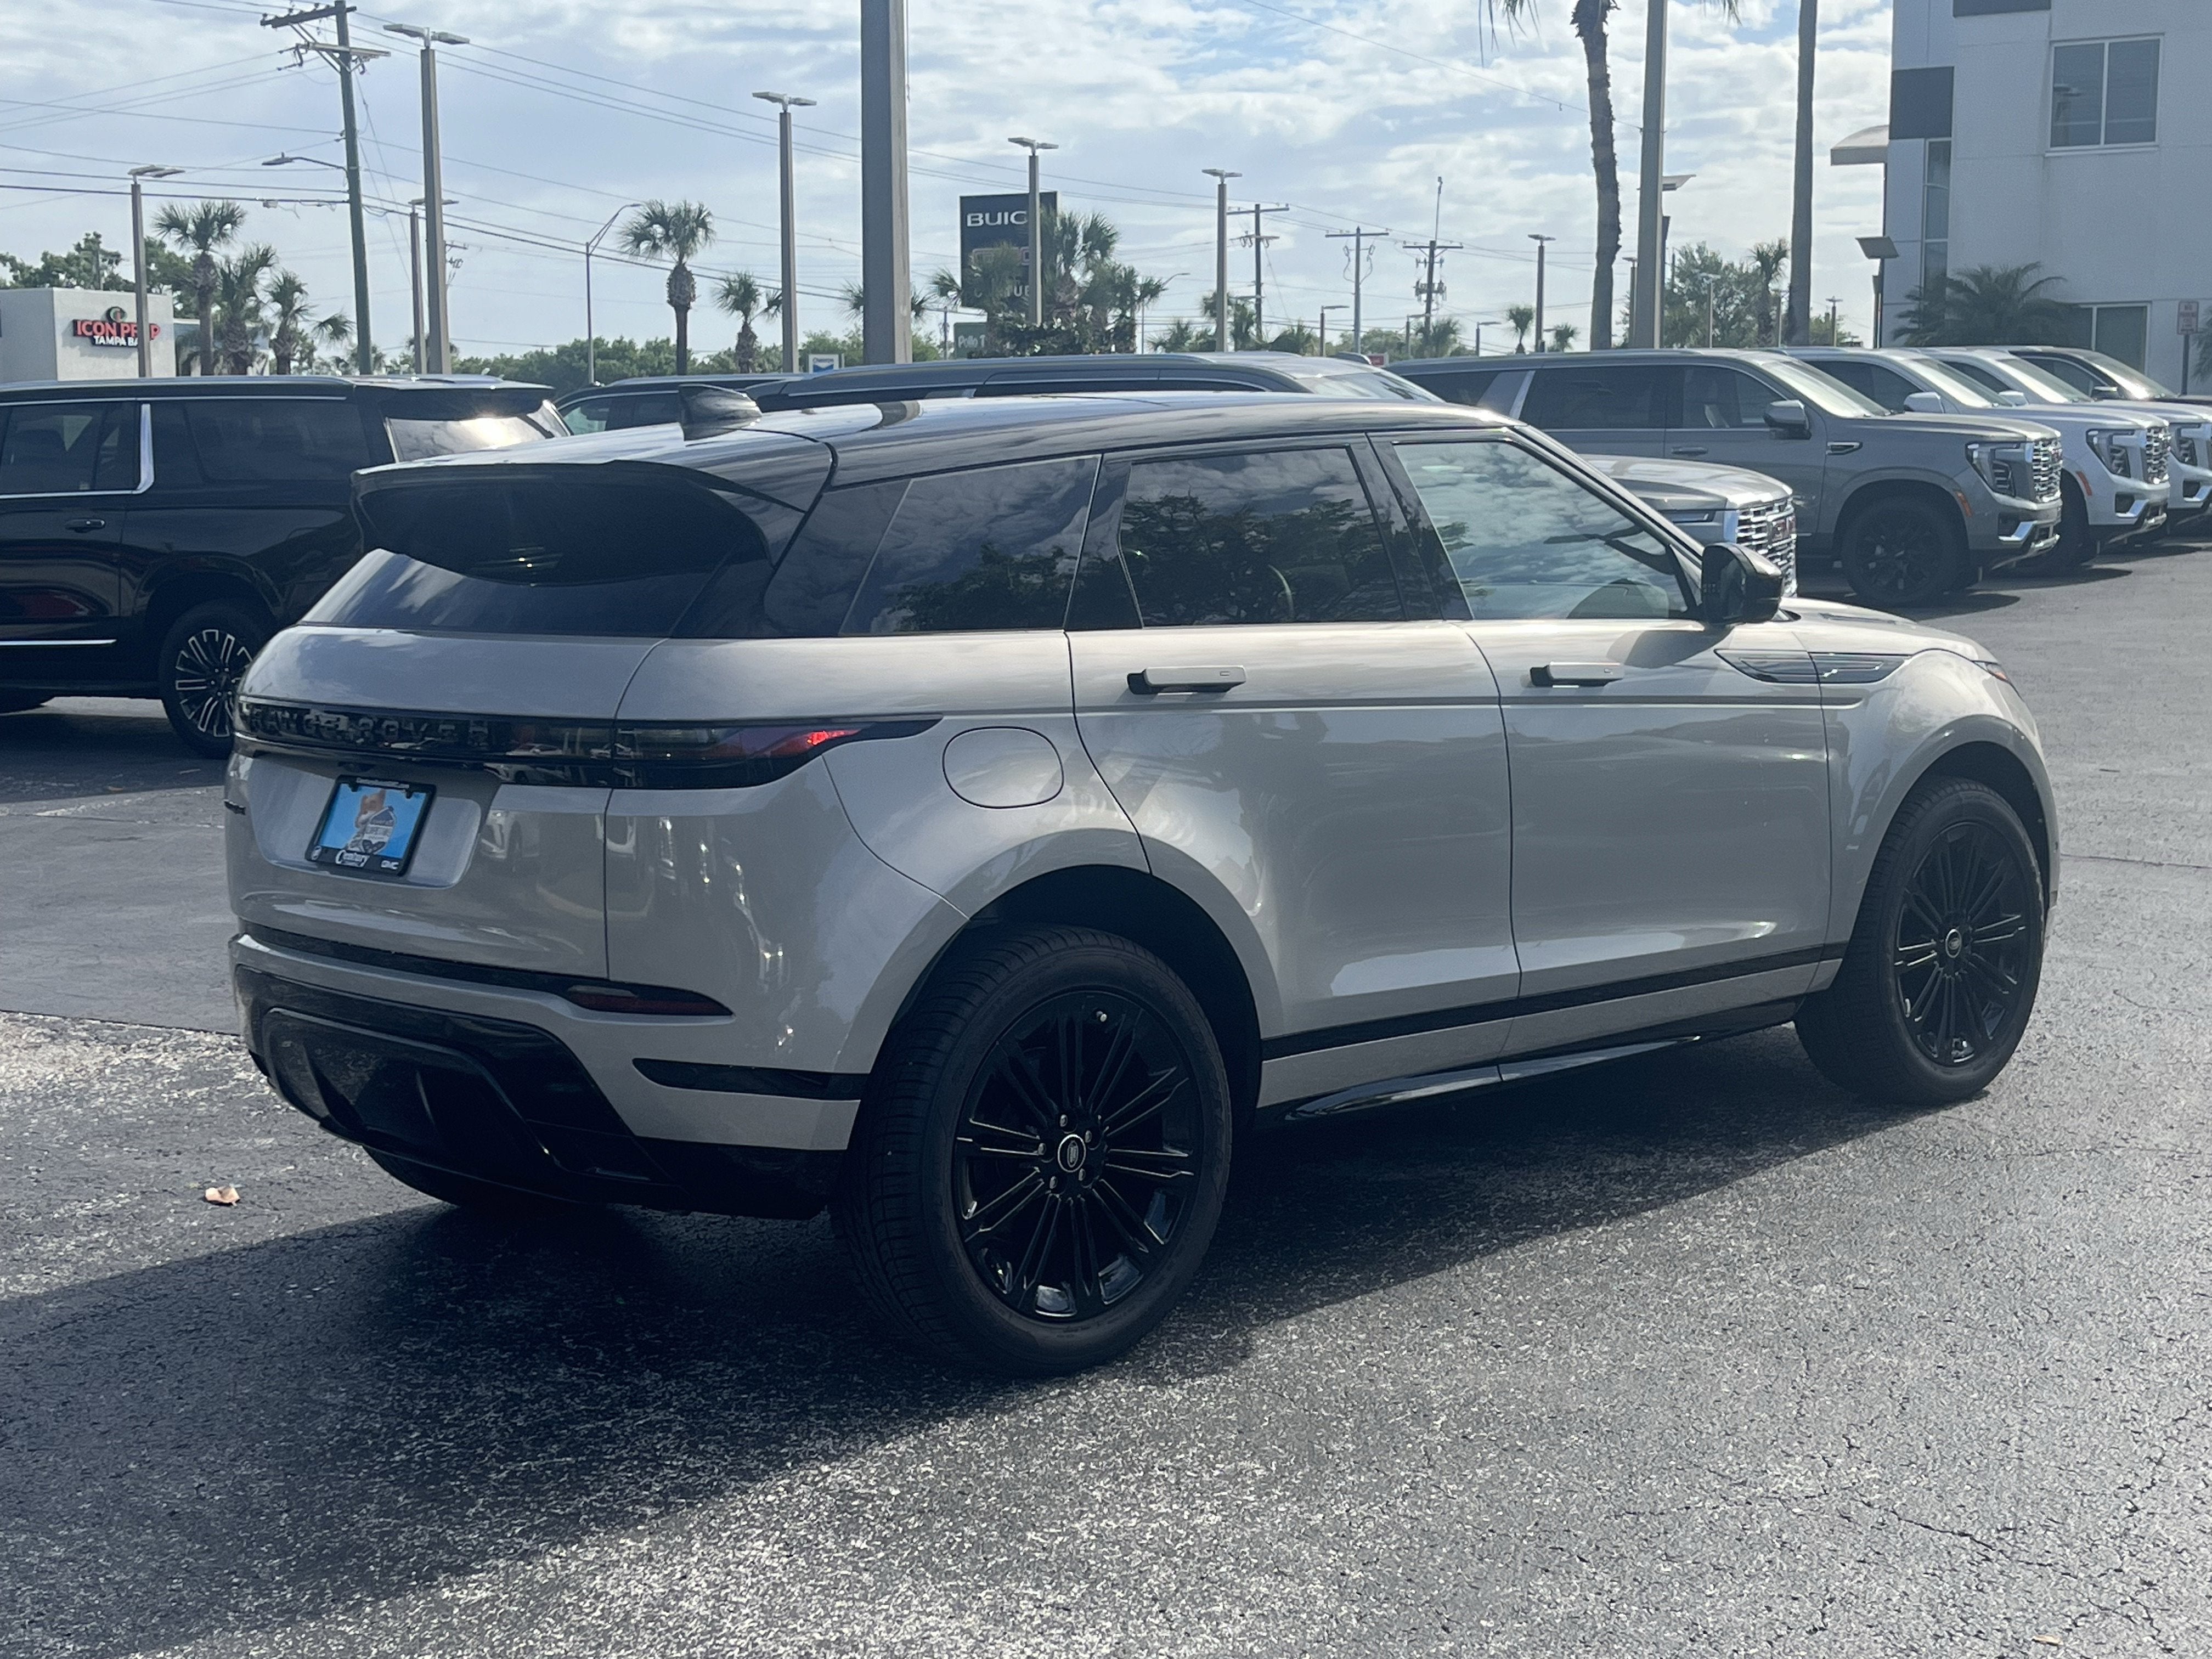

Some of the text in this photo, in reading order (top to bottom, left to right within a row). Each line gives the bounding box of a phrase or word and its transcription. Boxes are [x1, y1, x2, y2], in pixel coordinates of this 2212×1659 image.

[967, 211, 1028, 227] BUIC
[77, 320, 161, 338] ICON PRP
[93, 336, 127, 346] TAMPA
[958, 335, 978, 348] Pollo
